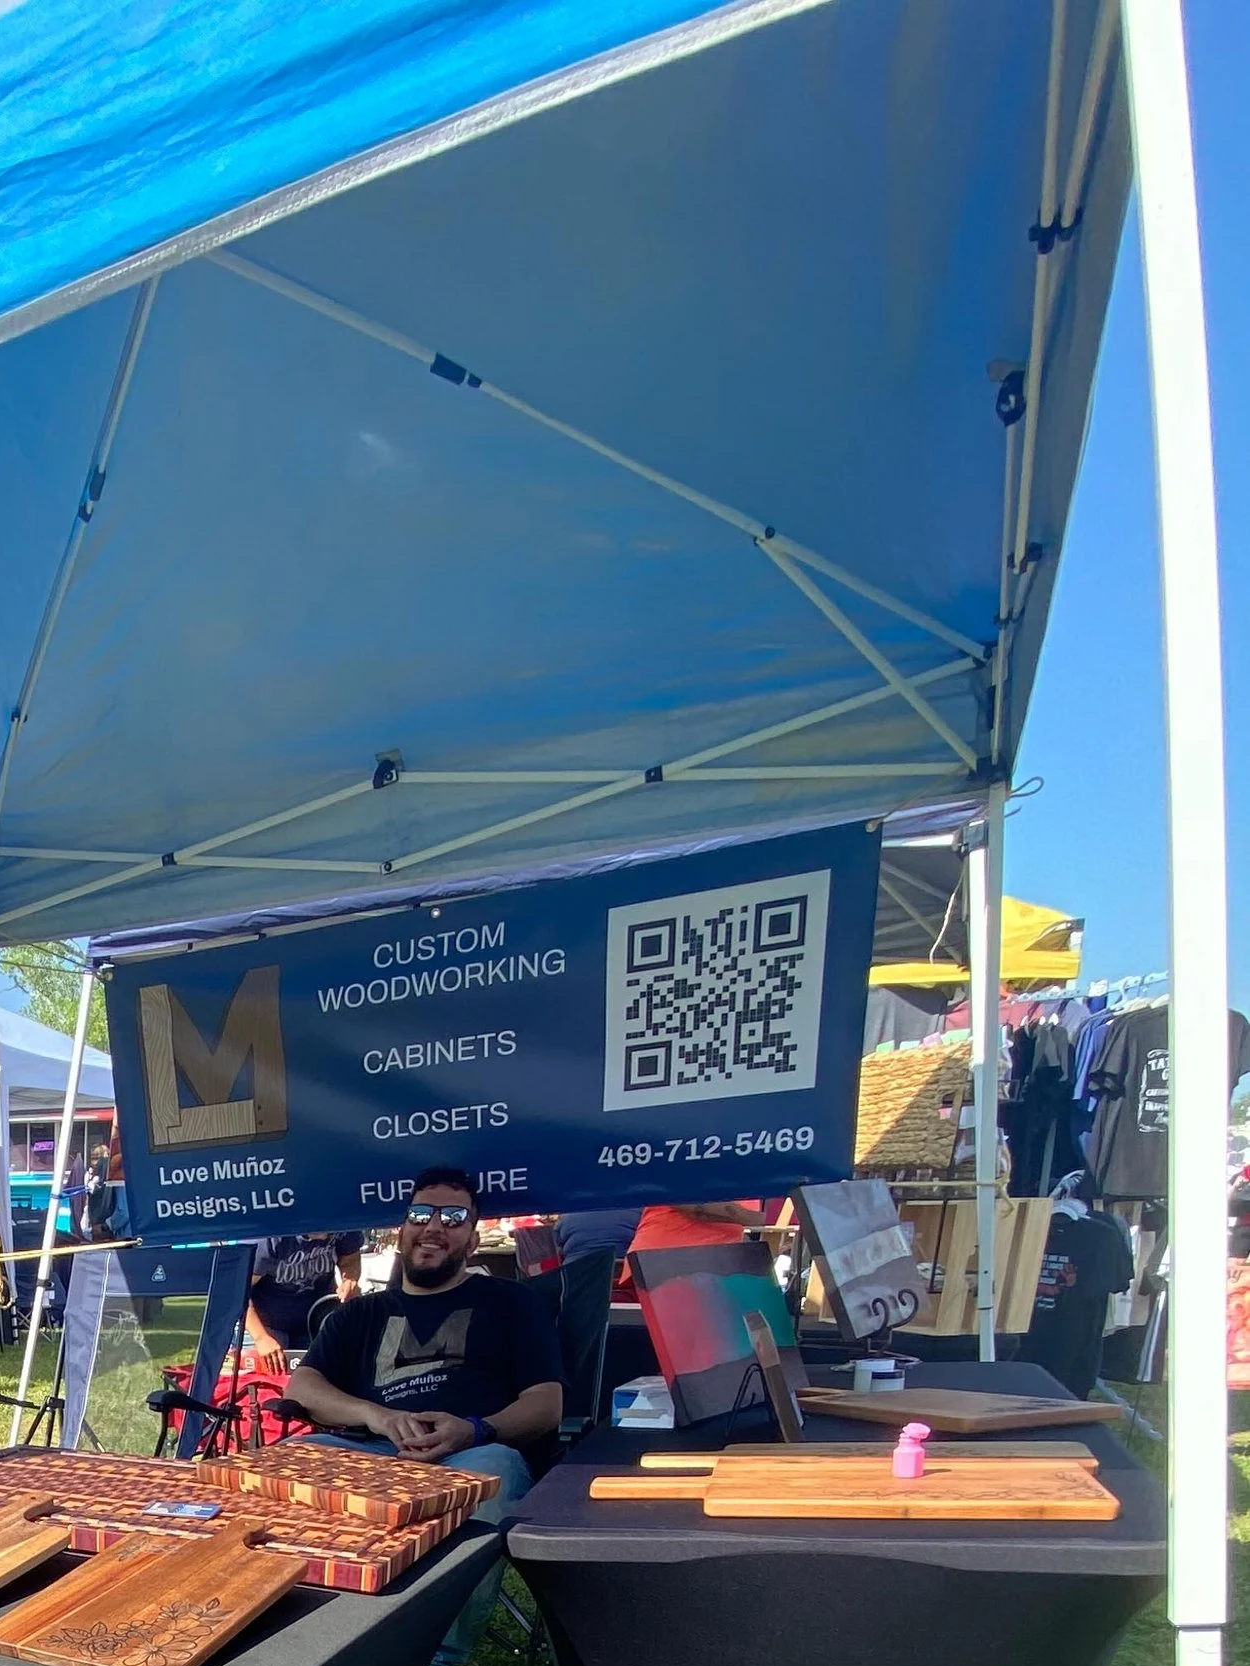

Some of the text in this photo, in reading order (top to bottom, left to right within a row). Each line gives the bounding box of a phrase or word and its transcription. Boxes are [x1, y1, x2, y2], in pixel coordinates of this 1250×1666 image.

[372, 921, 506, 969] CUSTOM
[317, 948, 567, 1013] WOODWORKING
[363, 1029, 517, 1074] CABINETS
[372, 1101, 509, 1140] CLOSETS
[597, 1125, 815, 1168] 469-712-5469
[159, 1155, 286, 1186] Love Muñoz
[360, 1167, 529, 1204] FURRE
[156, 1187, 296, 1219] Designs, LLC
[381, 1374, 448, 1396] Love Muñoz
[420, 1383, 439, 1394] LLC
